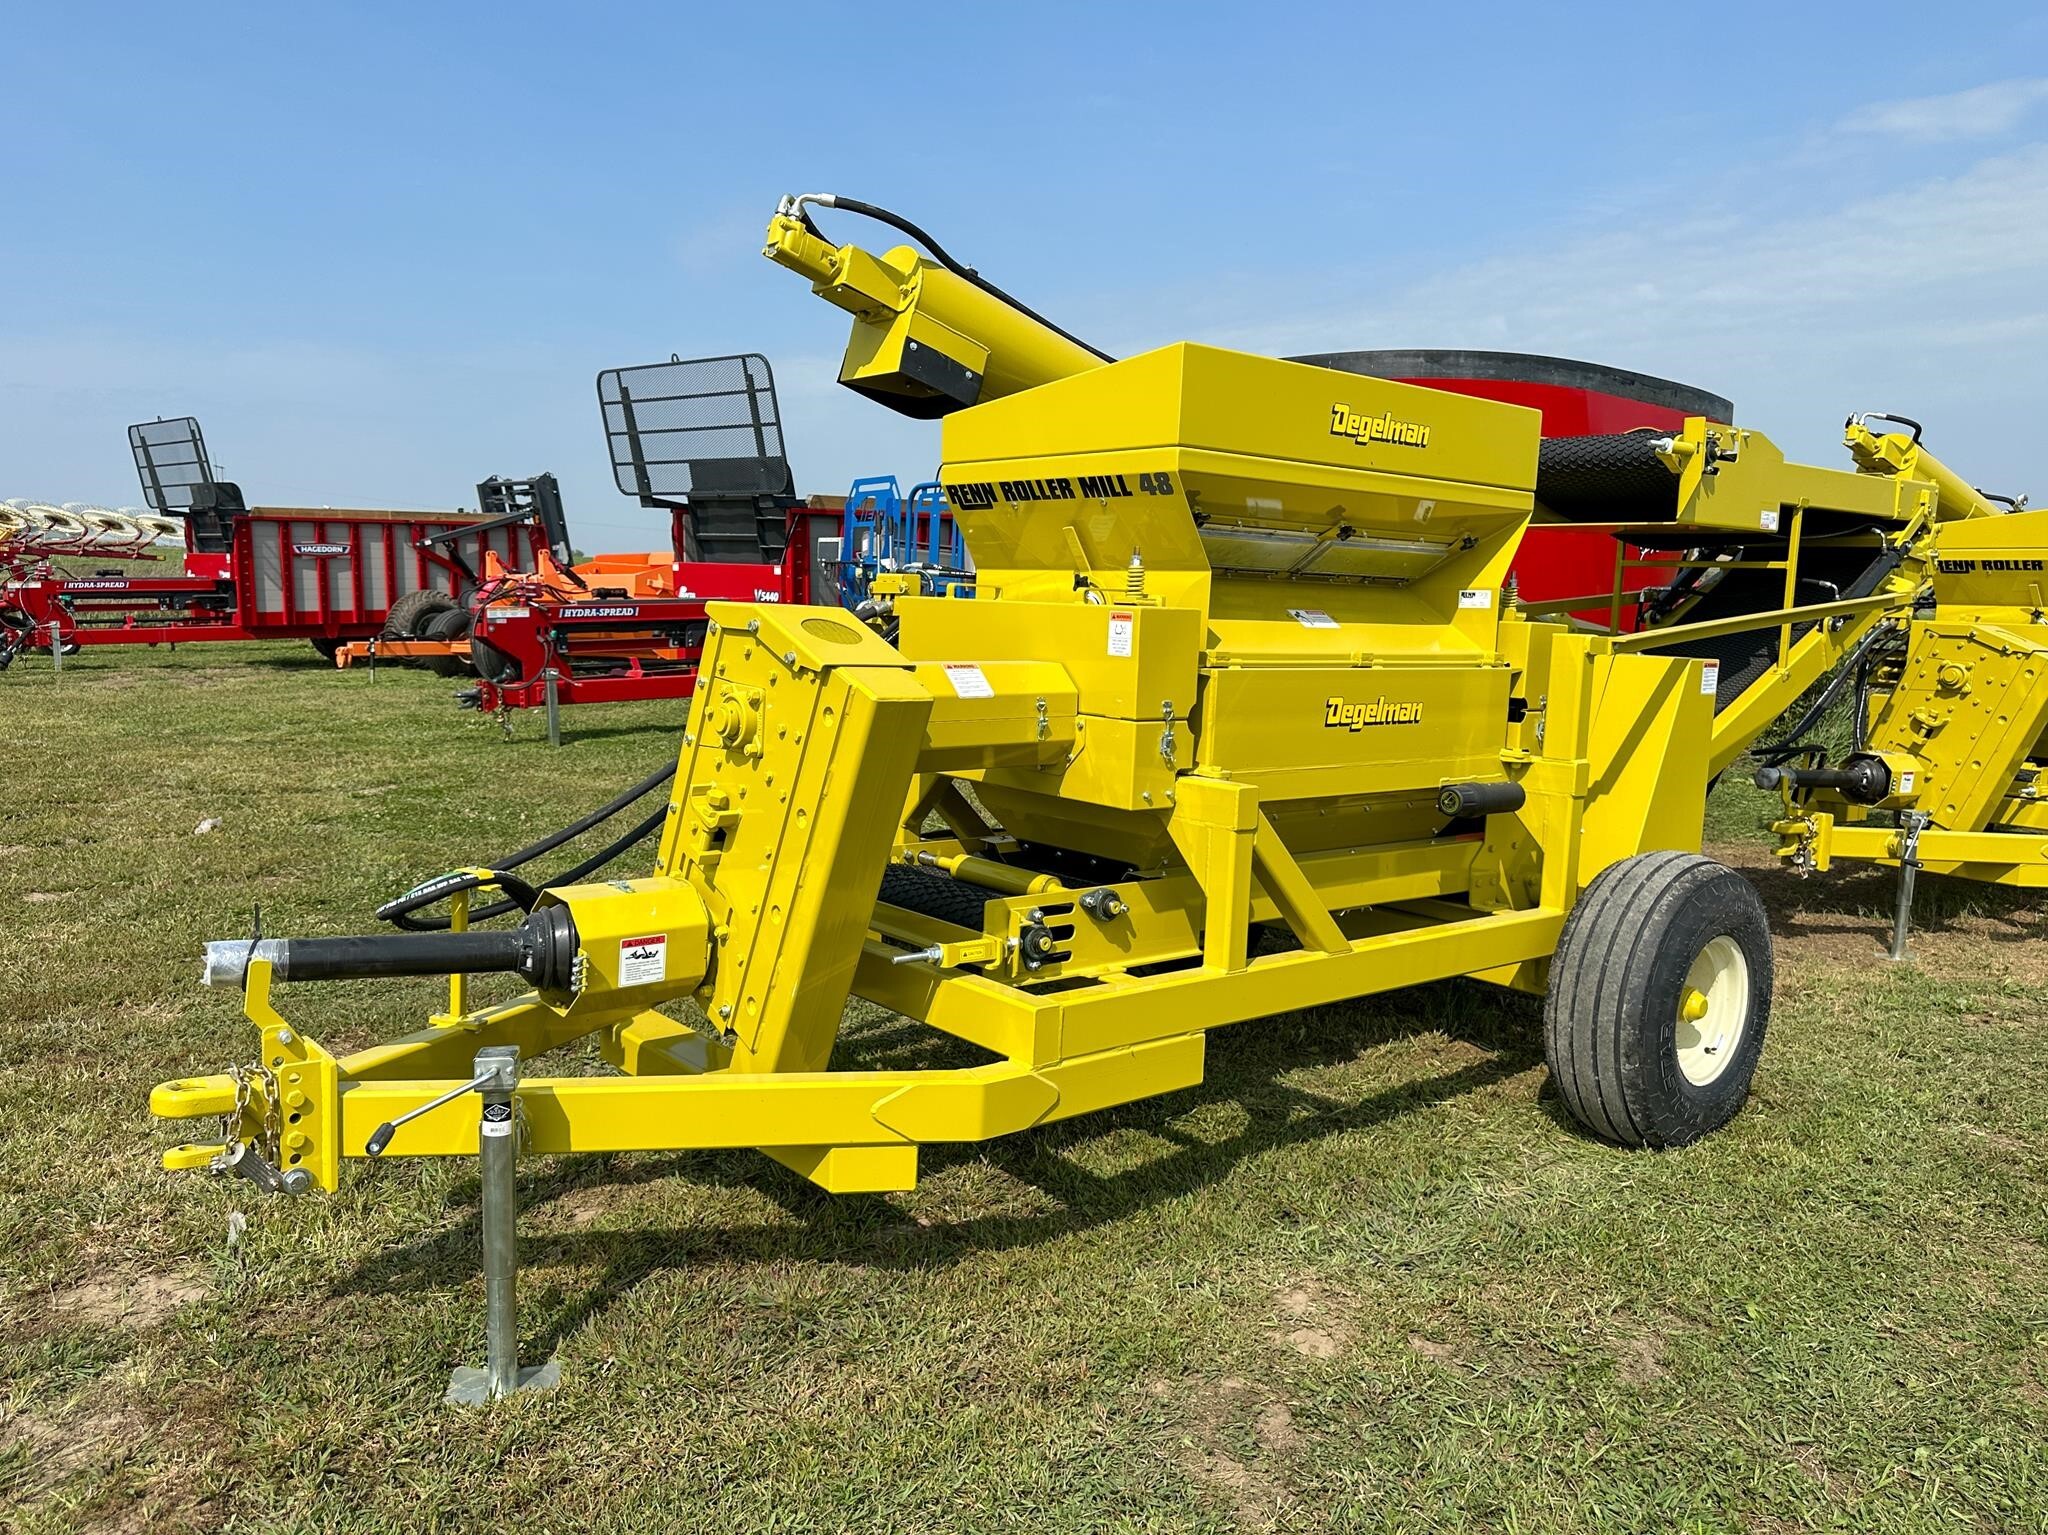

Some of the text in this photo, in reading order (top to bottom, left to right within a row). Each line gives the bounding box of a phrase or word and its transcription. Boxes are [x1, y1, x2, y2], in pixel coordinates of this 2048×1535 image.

[1330, 402, 1431, 448] Degelman
[946, 472, 1174, 510] RENN ROLLER MILL 48
[301, 545, 343, 553] HAGEDORN
[1981, 560, 2043, 571] ROLLER
[754, 589, 779, 602] V5440
[564, 607, 634, 617] HYDRA-SPREAD
[1325, 695, 1424, 732] Degelman
